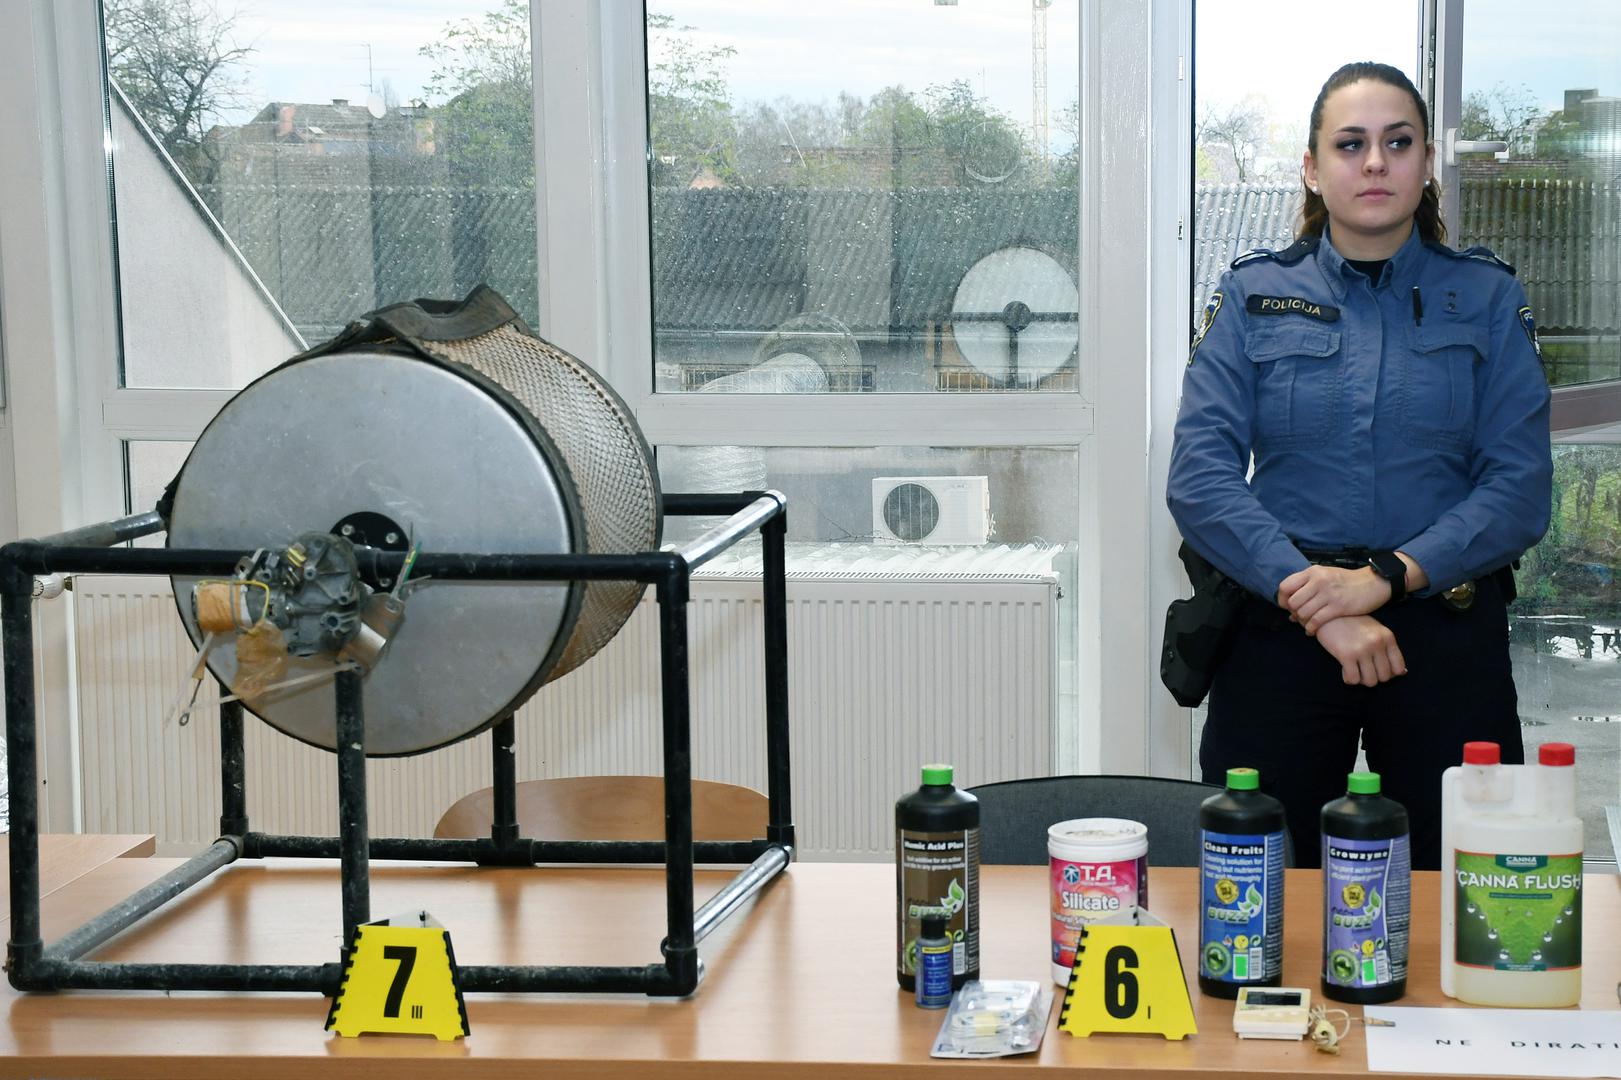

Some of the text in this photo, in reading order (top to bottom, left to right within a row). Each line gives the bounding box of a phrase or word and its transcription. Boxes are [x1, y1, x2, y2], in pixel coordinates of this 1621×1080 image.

[1261, 298, 1321, 316] POLICIJA
[927, 842, 946, 851] Acid
[1205, 842, 1264, 855] Clean Fruits
[1080, 865, 1116, 881] T.A.
[1456, 869, 1581, 890] CANNA FLUSH
[1062, 890, 1119, 911] Silicate
[1208, 907, 1249, 924] BUZZ
[1333, 914, 1372, 929] BUZZ
[383, 945, 417, 1019] 7
[1104, 945, 1139, 1020] 6
[1511, 1041, 1619, 1049] DIRATI
